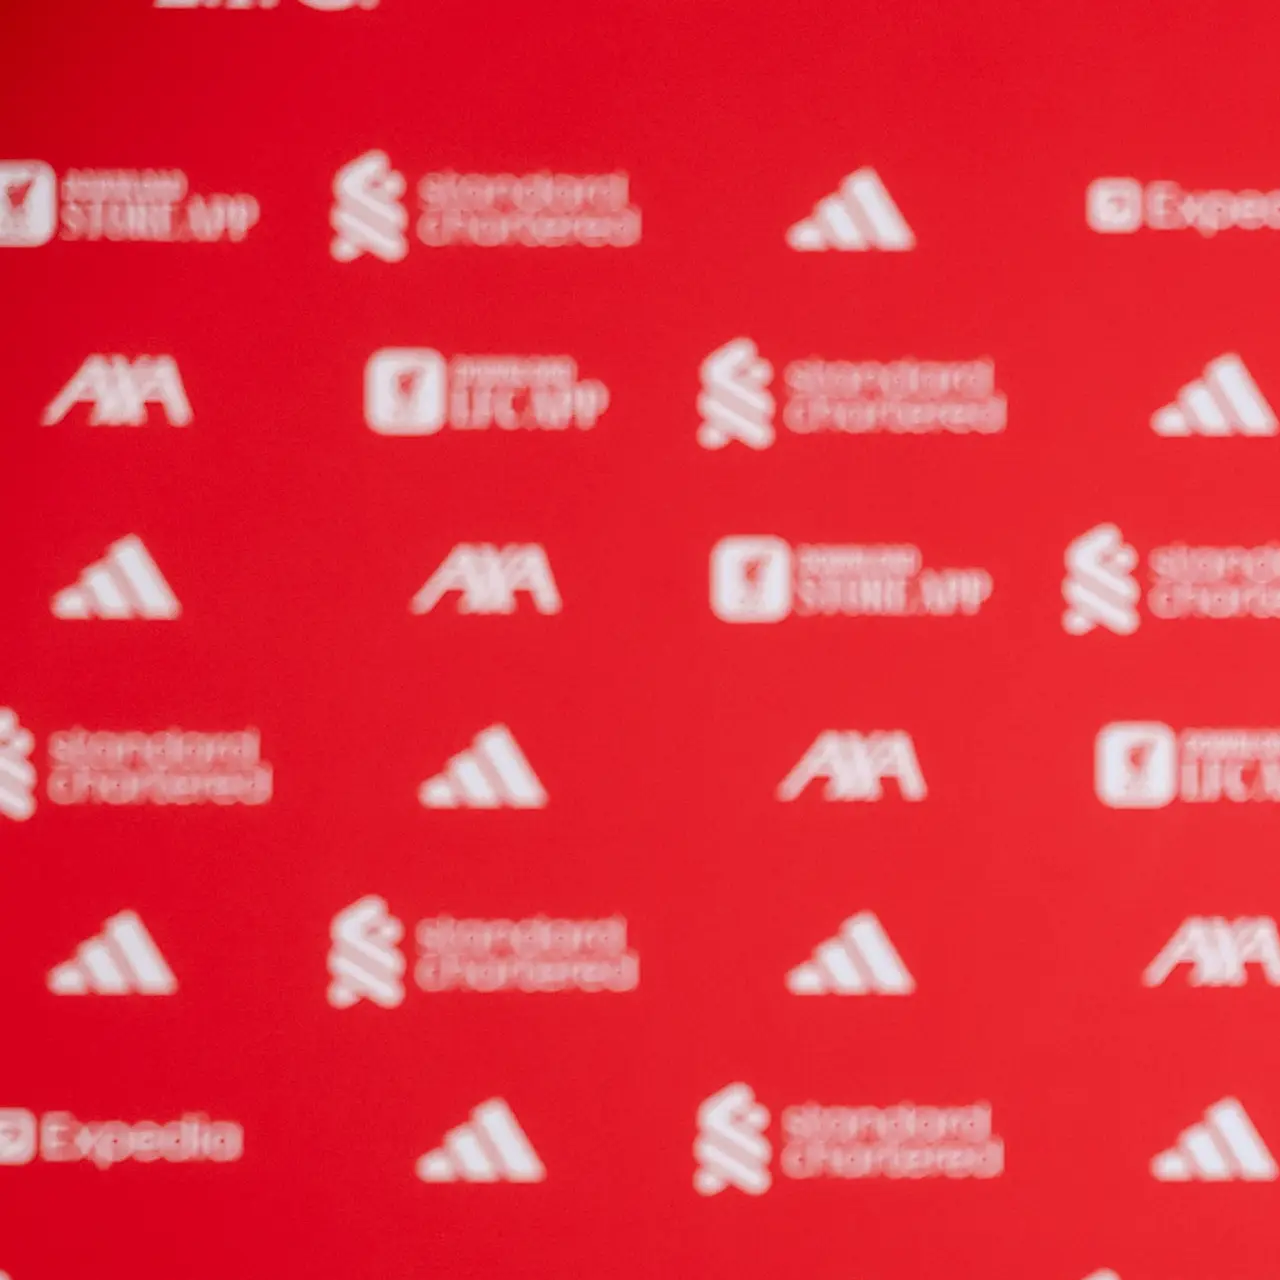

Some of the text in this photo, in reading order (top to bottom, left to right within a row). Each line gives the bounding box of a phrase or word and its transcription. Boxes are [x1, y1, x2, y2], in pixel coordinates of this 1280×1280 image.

[417, 170, 630, 208] standard
[416, 206, 642, 248] chartered
[44, 355, 192, 426] AXA
[784, 357, 996, 396] standard
[783, 394, 1007, 434] chartered
[412, 543, 562, 615] AXA
[48, 726, 261, 766] standard
[777, 730, 928, 802] AXA
[46, 764, 273, 806] chartered
[415, 914, 628, 954] standard
[414, 952, 640, 993] chartered
[41, 1110, 244, 1170] Expedia
[782, 1103, 993, 1142] standard
[781, 1140, 1004, 1179] chartered
